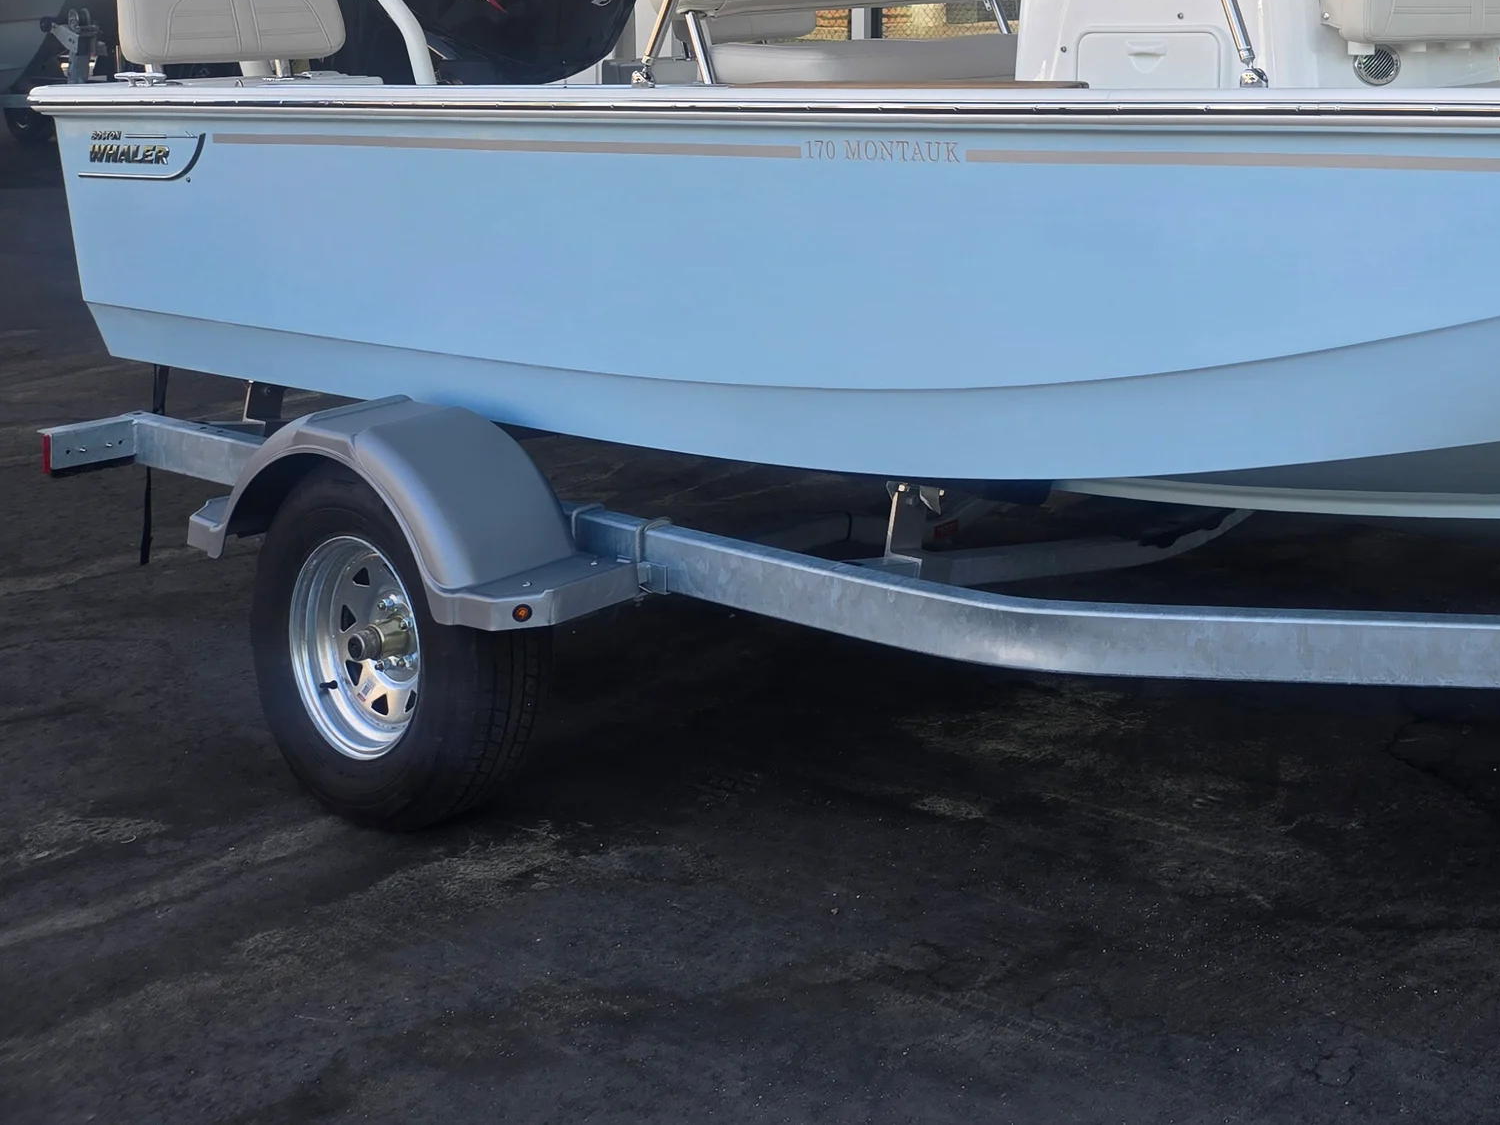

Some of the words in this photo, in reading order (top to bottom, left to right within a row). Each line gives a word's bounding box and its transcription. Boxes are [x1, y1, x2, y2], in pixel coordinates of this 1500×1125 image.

[91, 131, 122, 141] BOSTON
[89, 144, 170, 165] WHALER
[805, 140, 836, 161] 170
[844, 140, 961, 163] MONTAUK
